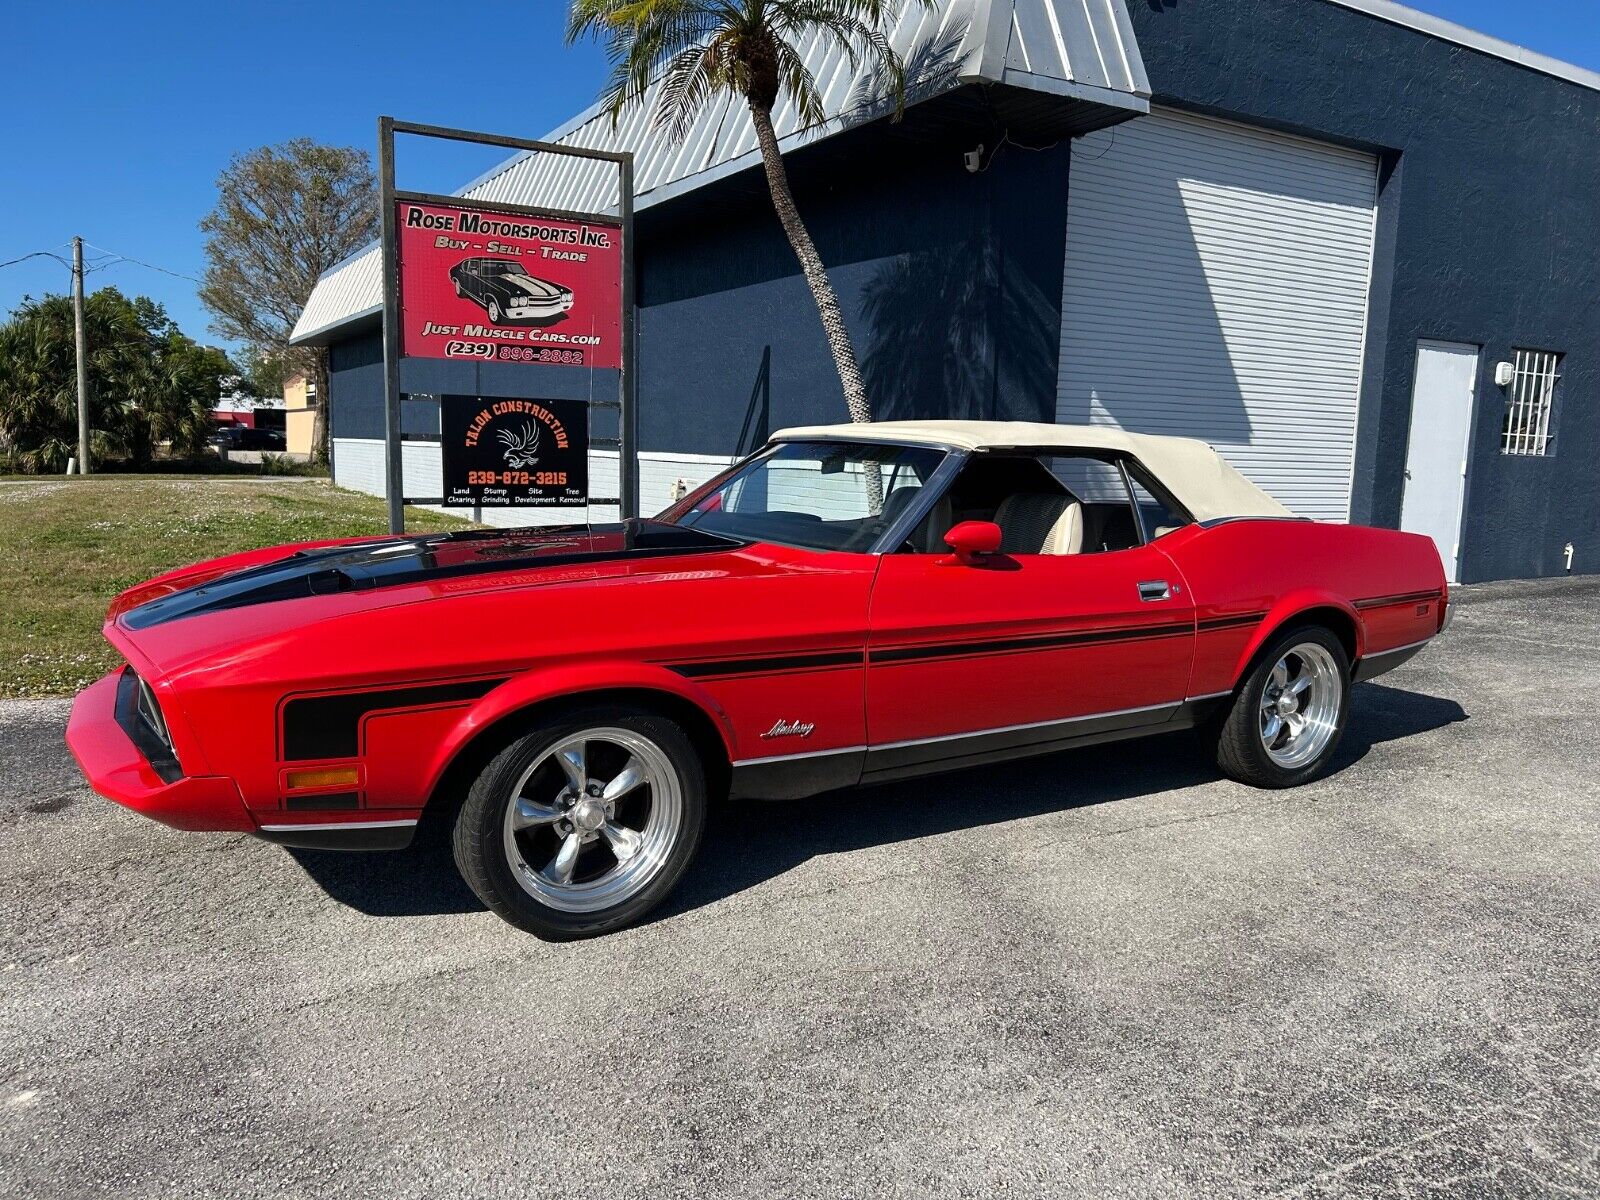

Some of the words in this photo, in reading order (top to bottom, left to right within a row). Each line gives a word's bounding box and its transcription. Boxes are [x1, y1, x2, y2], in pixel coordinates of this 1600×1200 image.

[407, 207, 454, 230] ROSE
[458, 212, 578, 243] MOTORSPORTS
[434, 236, 469, 250] BUY
[486, 241, 522, 256] SELL
[539, 246, 588, 262] TRADE
[422, 321, 460, 336] JUST
[463, 324, 525, 341] MUSCLE
[446, 342, 495, 358] (239)
[499, 347, 583, 364] 896-2882
[465, 409, 493, 447] TALON
[492, 401, 569, 449] CONSTRUCTION
[468, 471, 567, 485] 239-872-3215
[447, 496, 476, 505] Clearing
[481, 496, 510, 505] Grinding
[515, 496, 556, 504] Development
[559, 496, 586, 504] Removal
[484, 488, 507, 496] Stump
